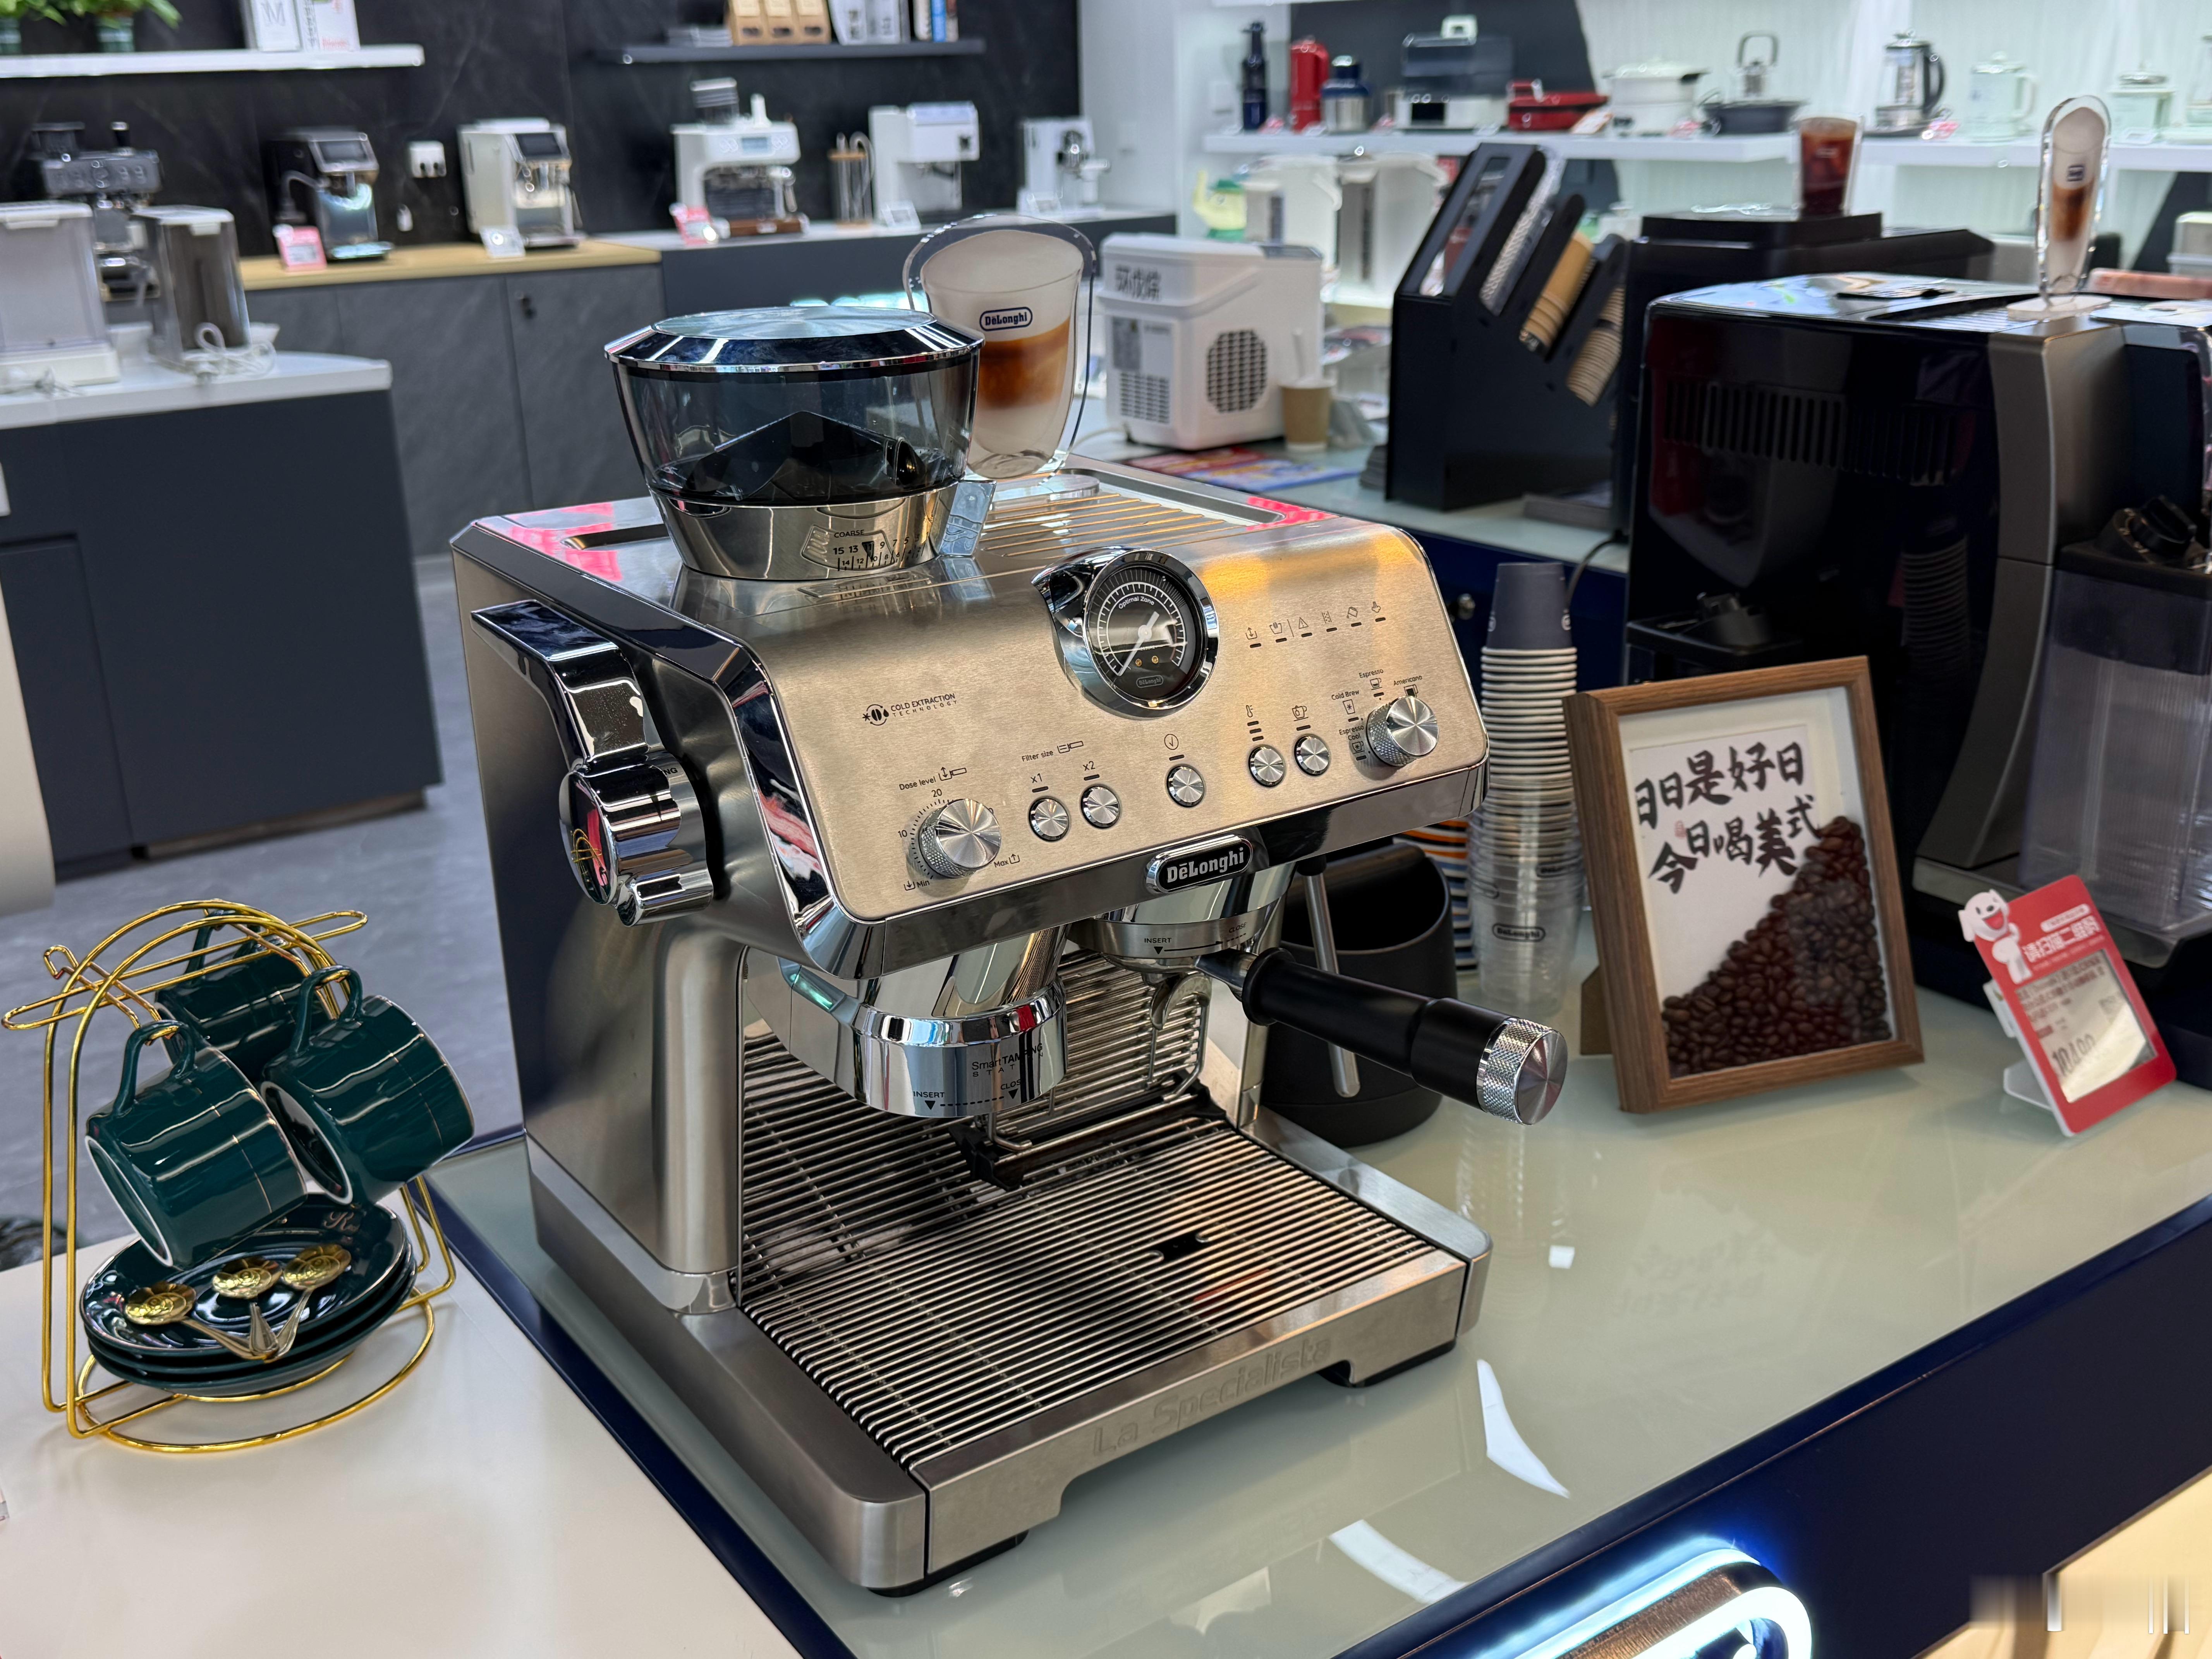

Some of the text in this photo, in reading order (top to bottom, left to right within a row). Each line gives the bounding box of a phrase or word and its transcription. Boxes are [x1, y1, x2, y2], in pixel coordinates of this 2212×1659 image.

[834, 529, 864, 538] COARSE
[833, 546, 844, 555] 15
[893, 539, 897, 547] 7
[1118, 596, 1155, 610] Optimal Zone
[1358, 668, 1384, 678] Espresso
[1393, 675, 1422, 686] Americano
[1331, 692, 1344, 701] Cold
[891, 693, 956, 712] COLD EXTRACTION
[892, 700, 957, 717] TECHNOLOGY
[1339, 725, 1364, 736] Espresso
[1021, 750, 1054, 762] Filter size
[1082, 761, 1096, 771] x2
[899, 776, 936, 790] Dose level
[1030, 773, 1042, 783] x1
[1635, 742, 1804, 830] 日日是好日
[931, 788, 942, 797] 20
[897, 829, 908, 839] 10
[1648, 794, 1822, 894] 今日喝美式
[917, 880, 930, 888] Min
[1228, 922, 1247, 933] CLOSE
[1000, 1079, 1024, 1090] CLOS
[1094, 1338, 1332, 1456] La Specialista
